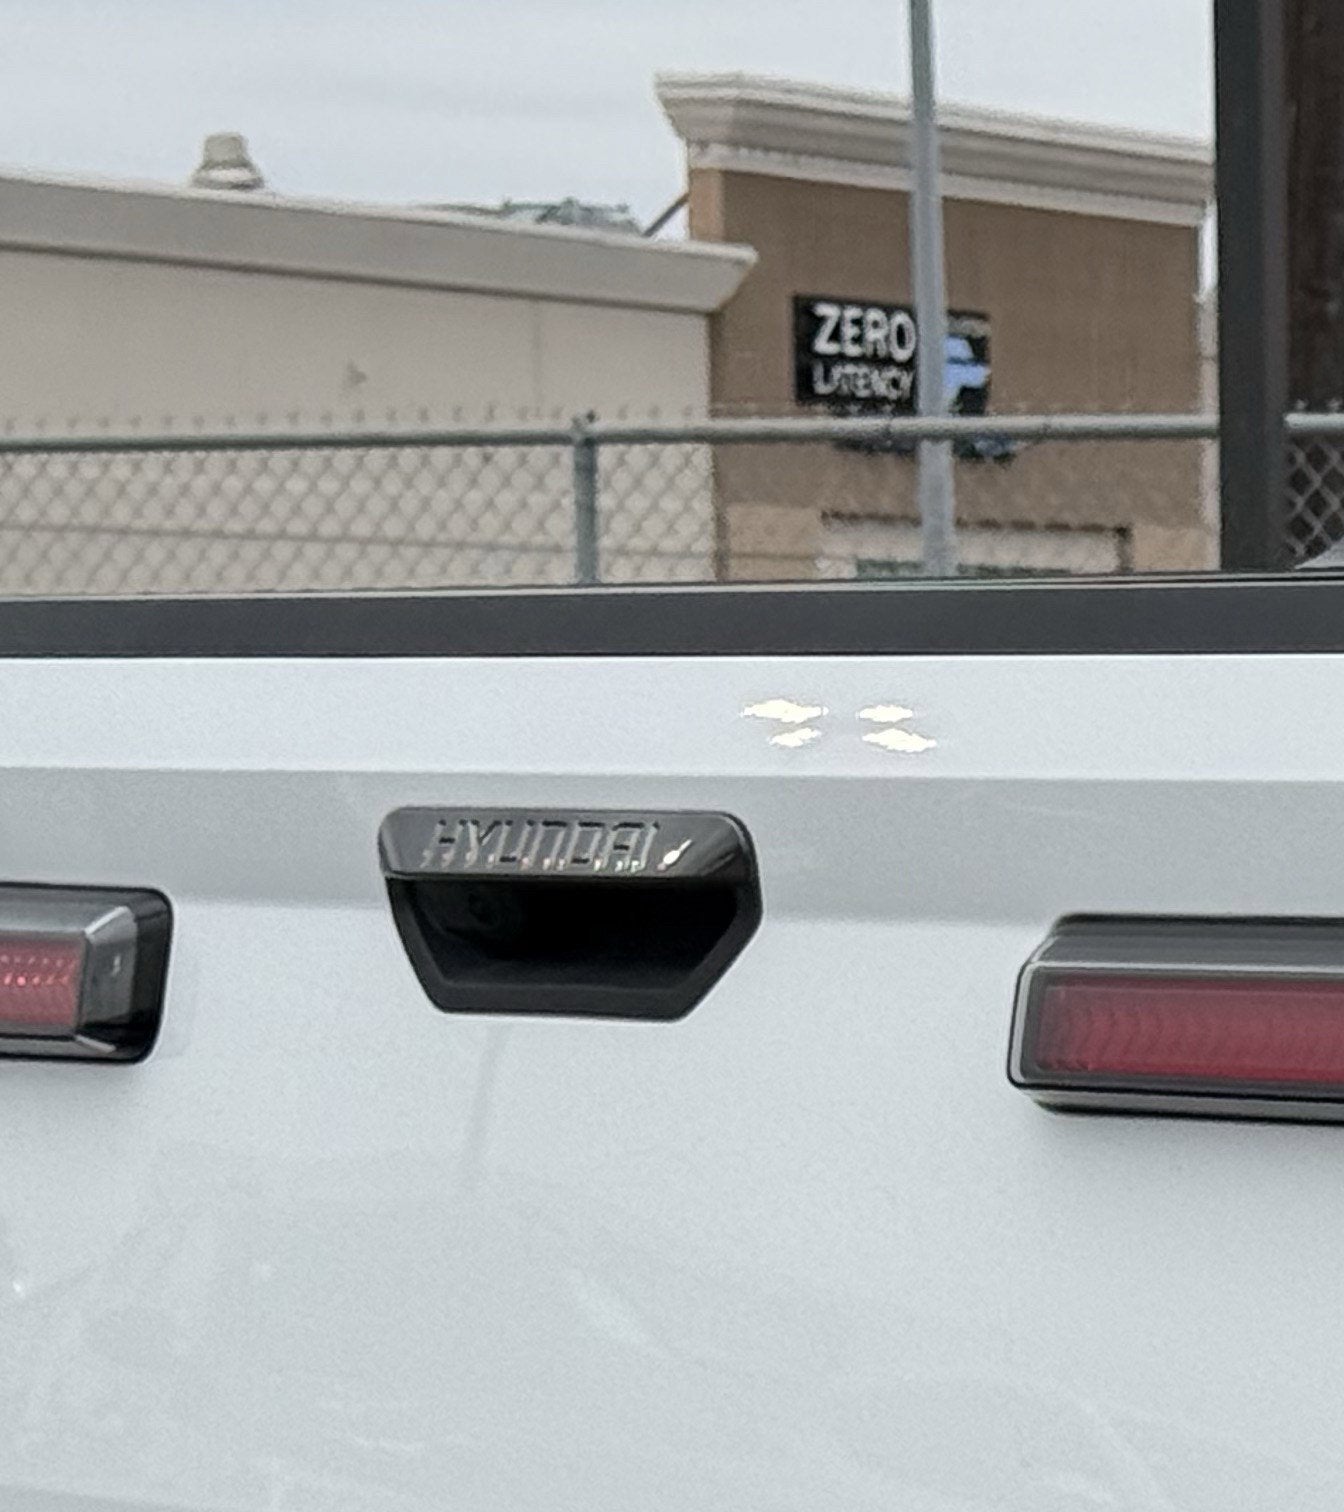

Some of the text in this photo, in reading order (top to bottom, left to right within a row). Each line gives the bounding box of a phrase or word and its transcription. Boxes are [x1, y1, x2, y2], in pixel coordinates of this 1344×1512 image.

[812, 301, 917, 363] ZERO
[811, 361, 914, 399] LATENCY
[420, 818, 660, 872] HYUNDAI
